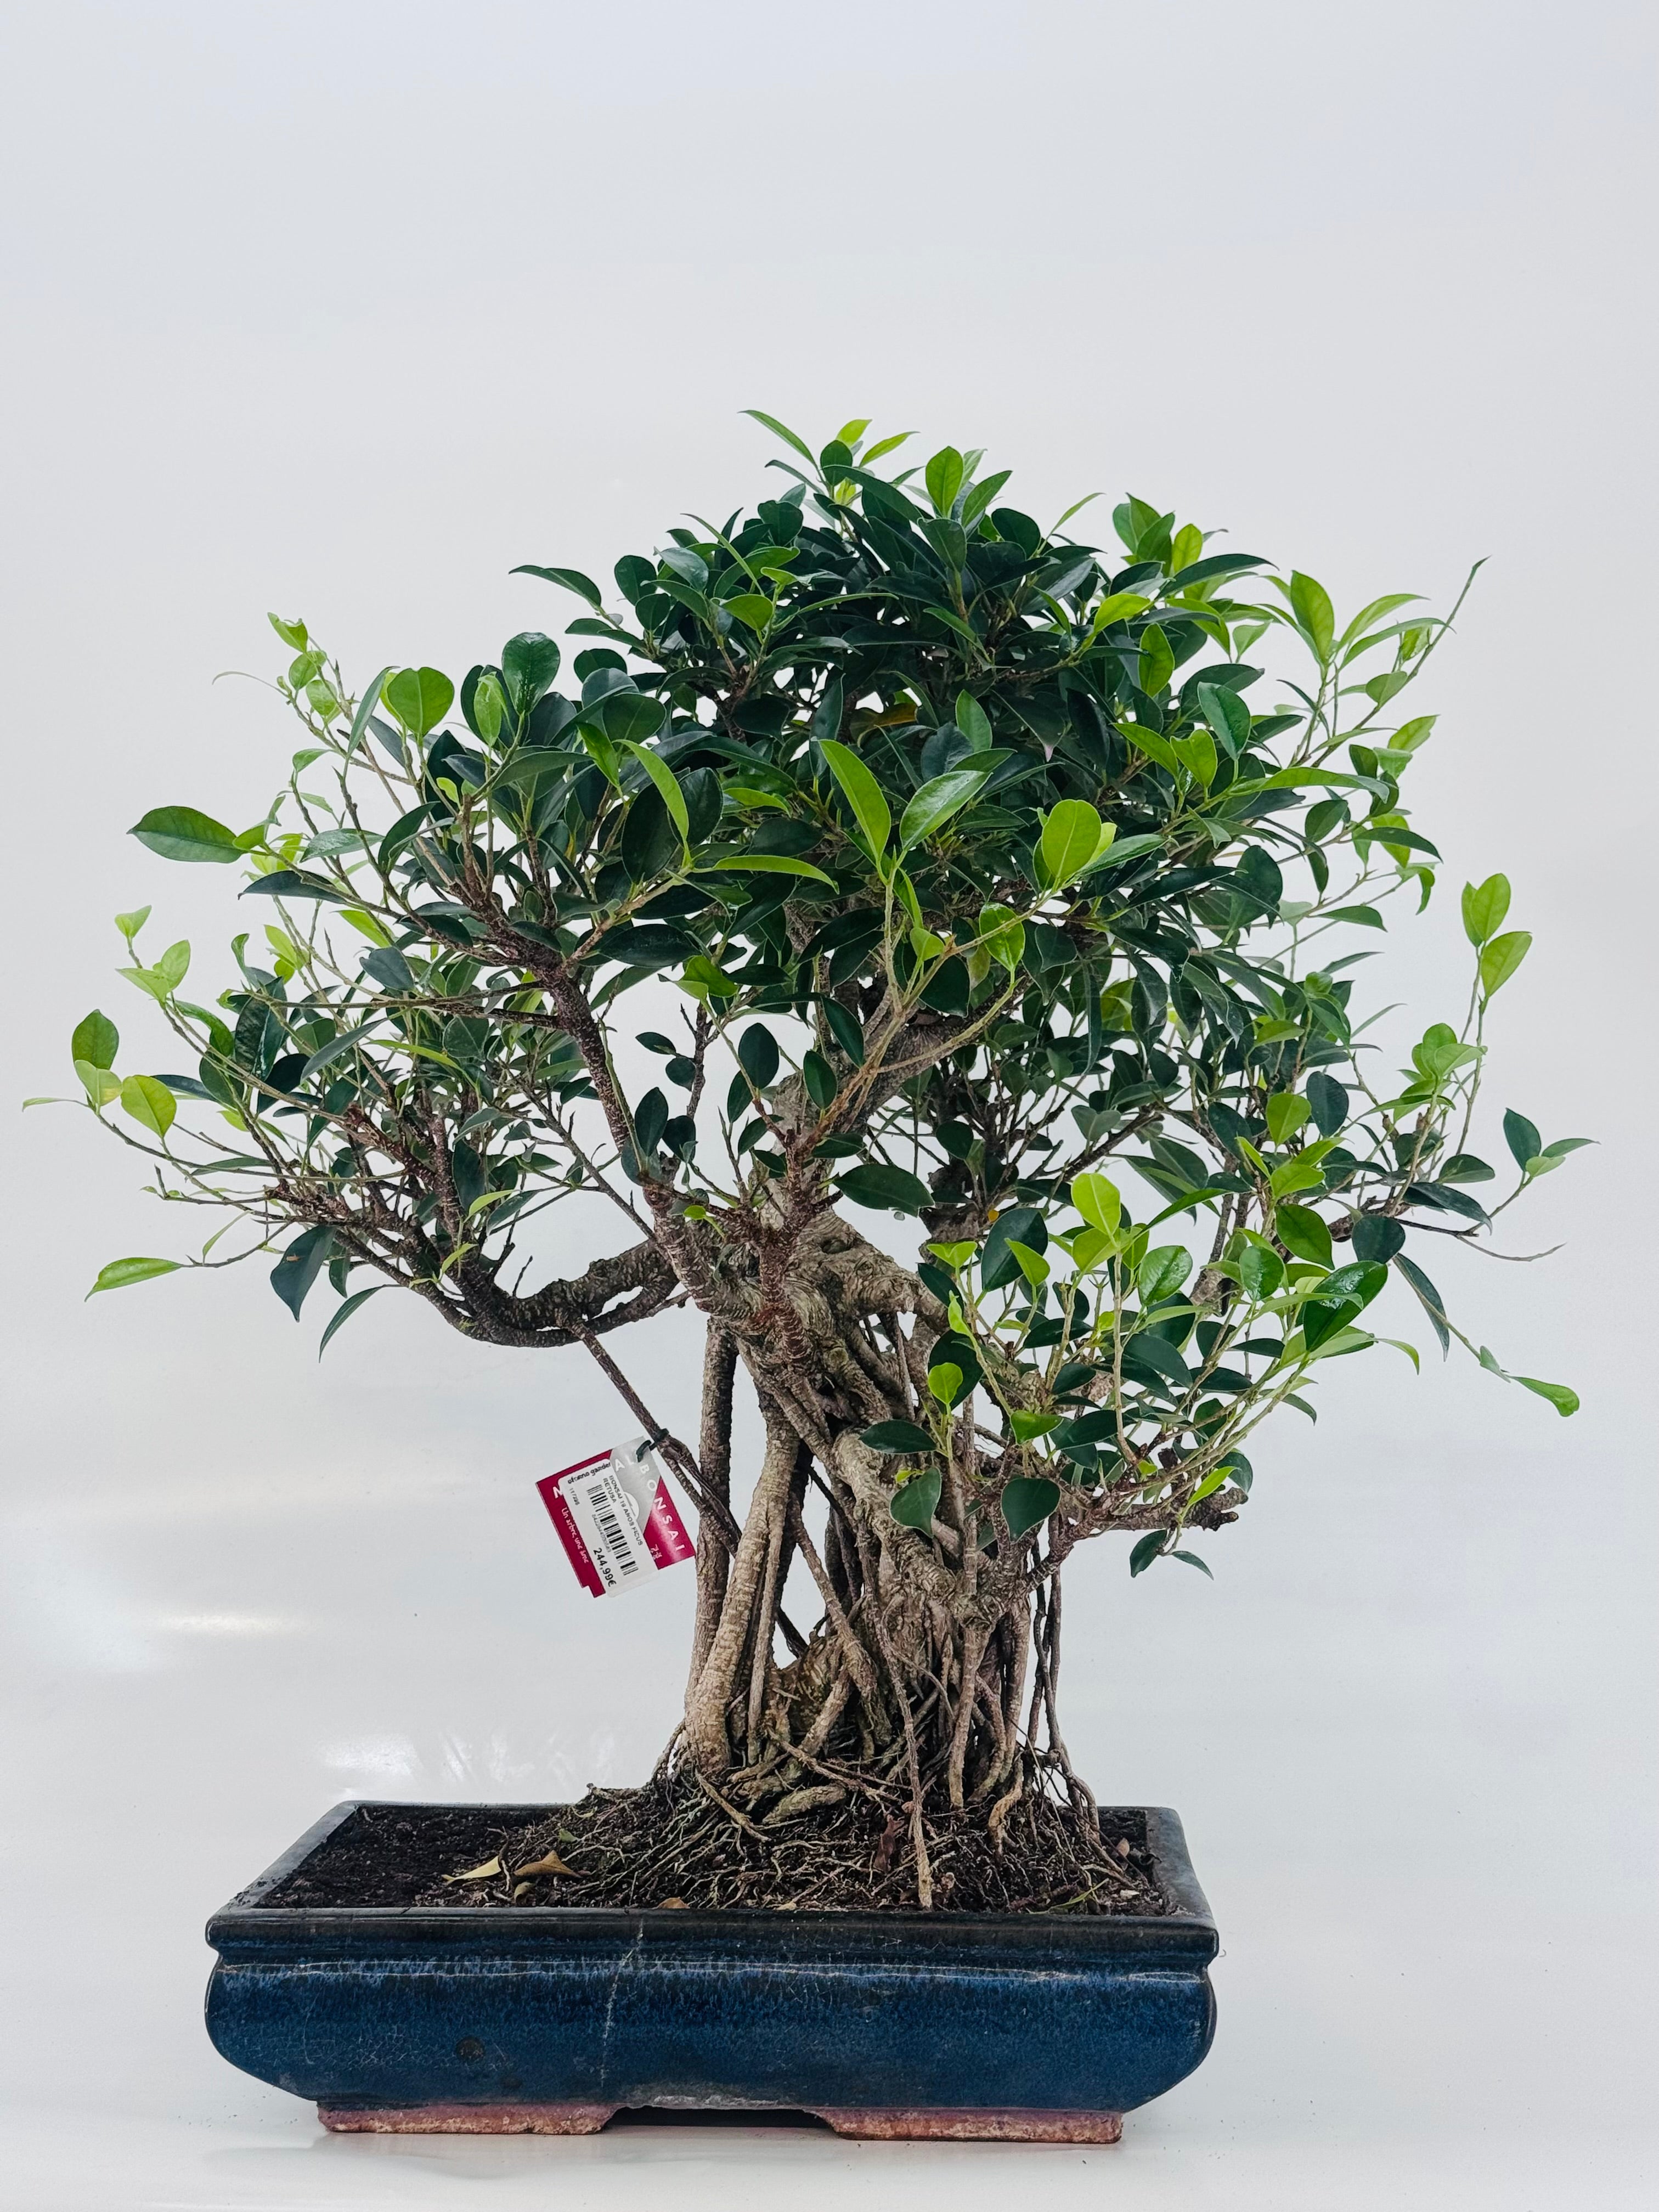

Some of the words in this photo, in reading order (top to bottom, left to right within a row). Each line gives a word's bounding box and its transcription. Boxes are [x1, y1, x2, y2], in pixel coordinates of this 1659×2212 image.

[602, 1478, 617, 1503] RETUSA
[561, 1507, 569, 1518] Un
[639, 1464, 685, 1551] BONSAI
[593, 1548, 617, 1588] 244,99€
